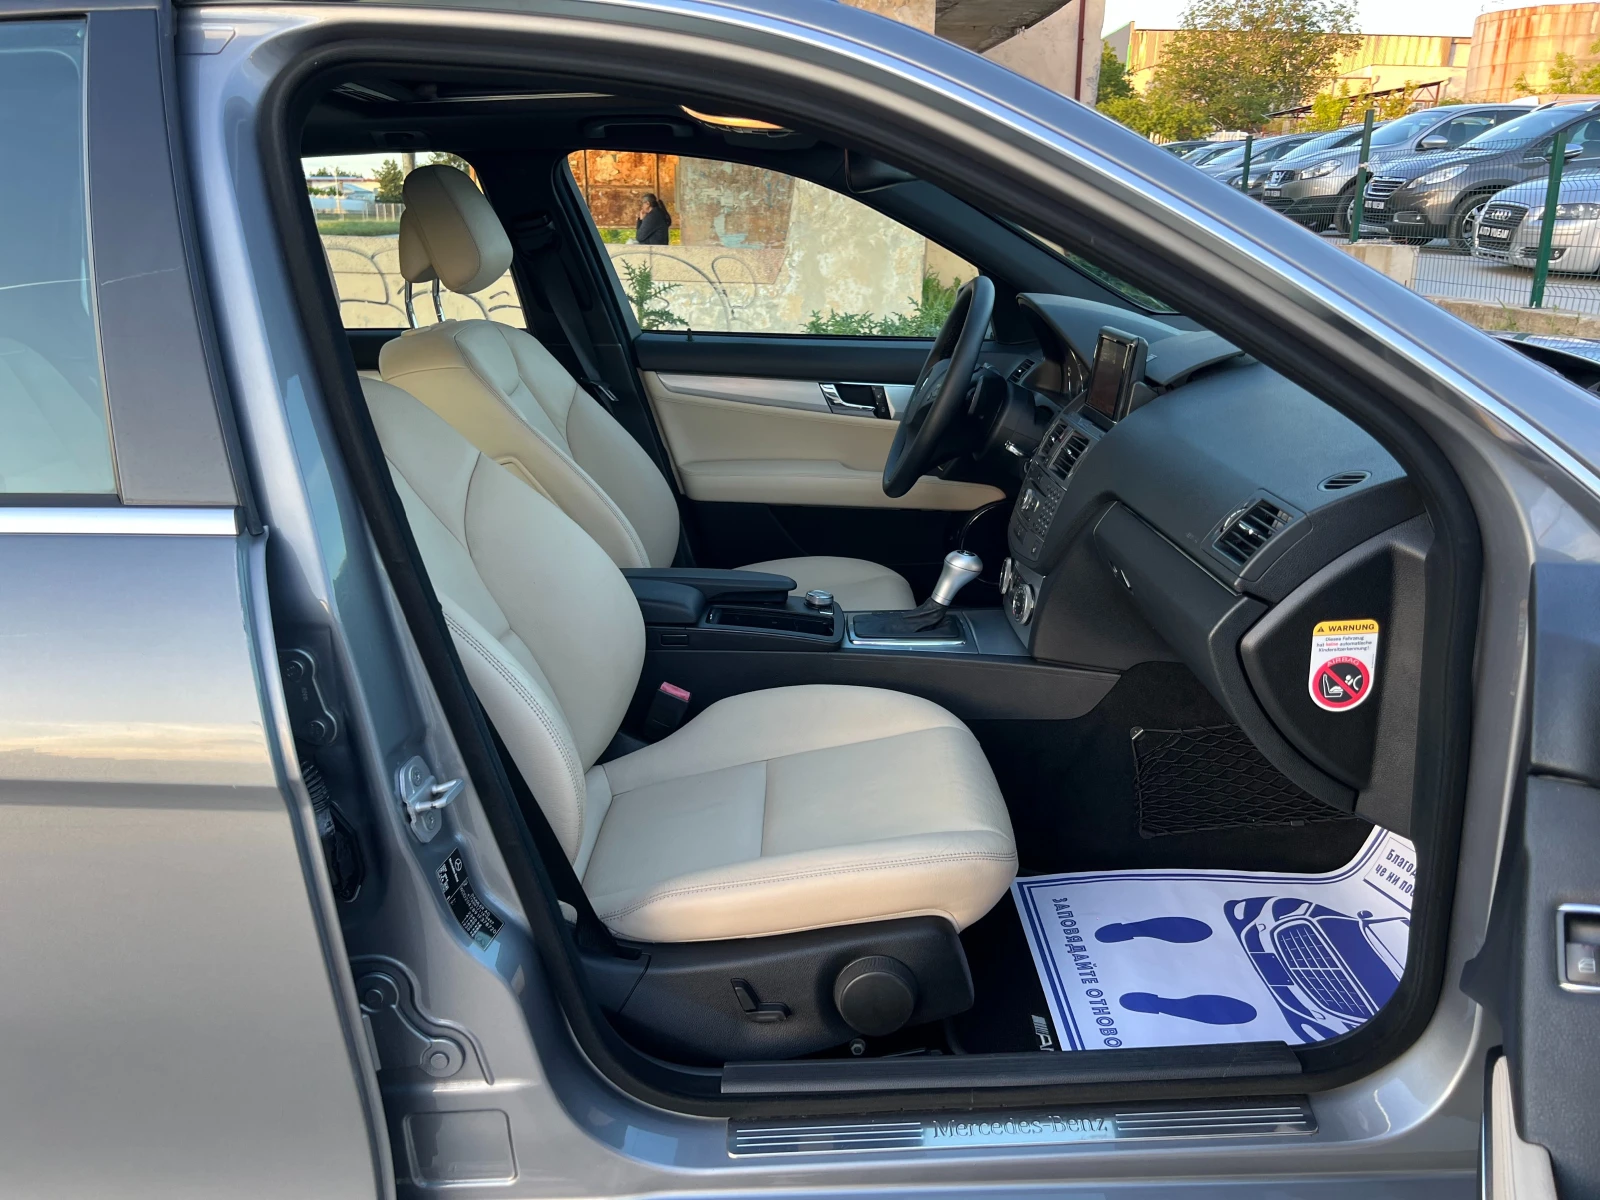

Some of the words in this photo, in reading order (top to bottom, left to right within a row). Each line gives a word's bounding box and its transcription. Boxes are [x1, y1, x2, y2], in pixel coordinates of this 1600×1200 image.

[1328, 623, 1375, 632] WARNUNG
[1327, 656, 1360, 667] AIRBAG
[1375, 862, 1388, 879] че
[1386, 871, 1401, 886] ни
[1051, 897, 1100, 986] ЗАПОВЯДАЙТЕ
[1085, 987, 1124, 1048] ОТНОВО
[932, 1115, 1108, 1139] Mercedes-Benz
